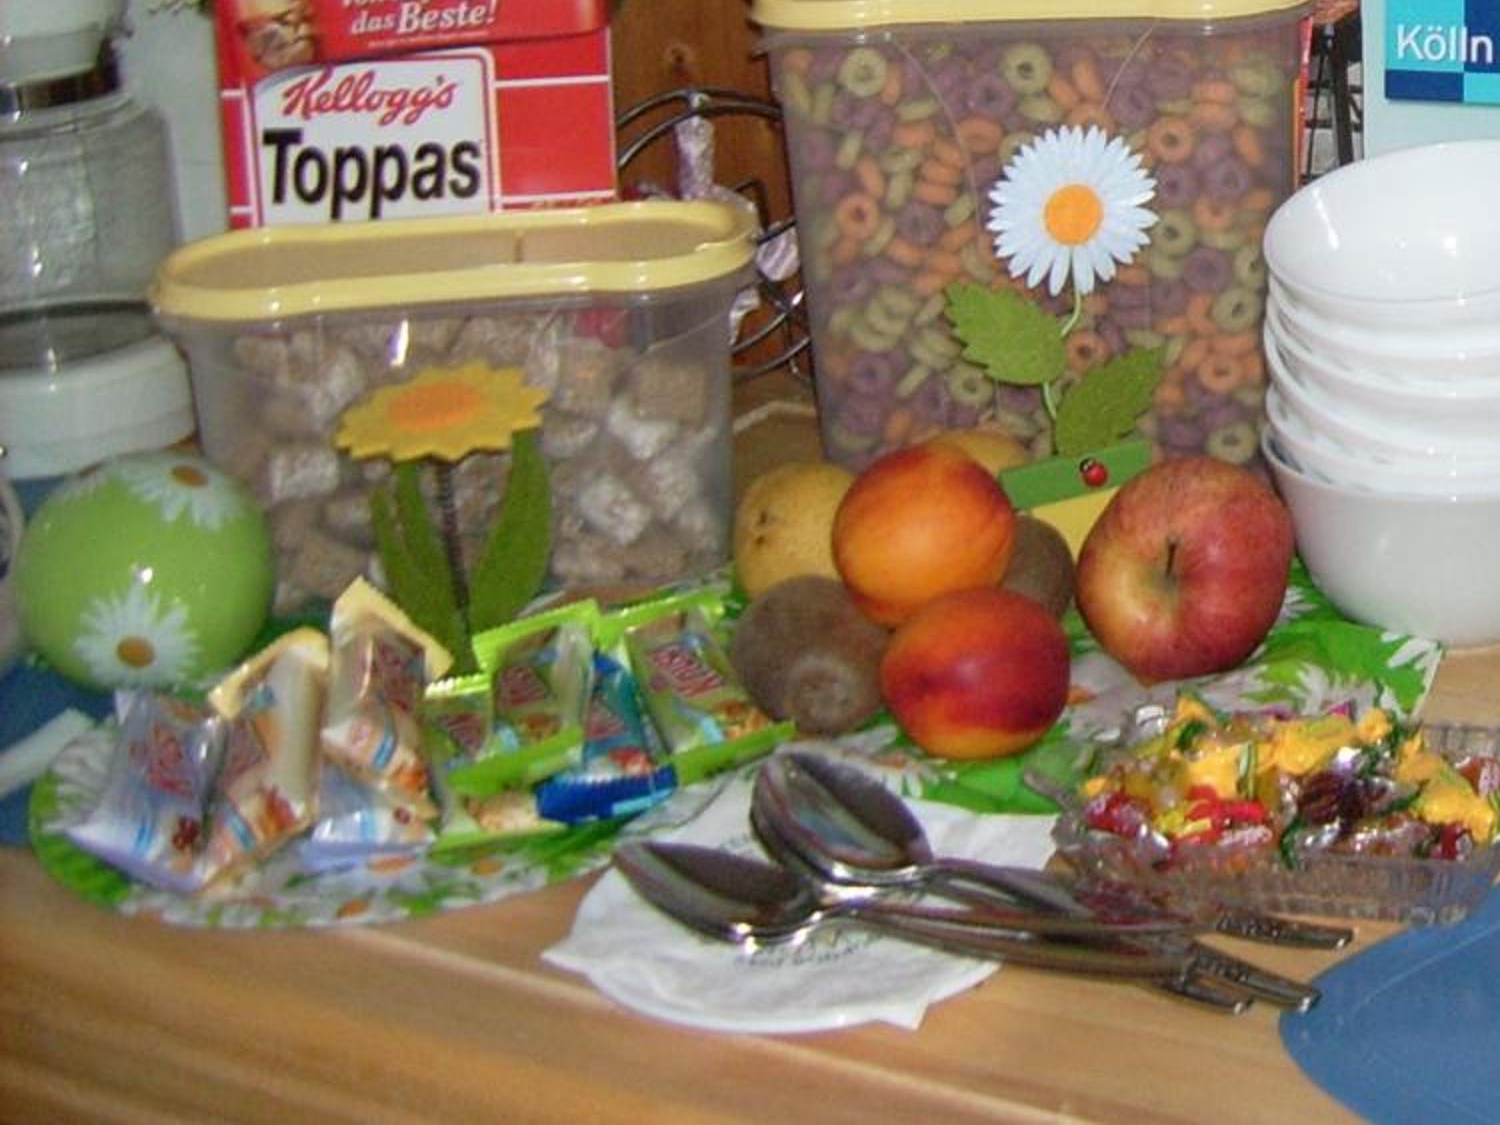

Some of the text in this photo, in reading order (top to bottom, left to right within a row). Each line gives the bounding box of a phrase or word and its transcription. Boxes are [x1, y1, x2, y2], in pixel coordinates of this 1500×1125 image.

[351, 11, 399, 35] das
[1396, 24, 1494, 64] Kölln
[283, 64, 459, 127] Kellogg's
[262, 128, 482, 221] Toppas
